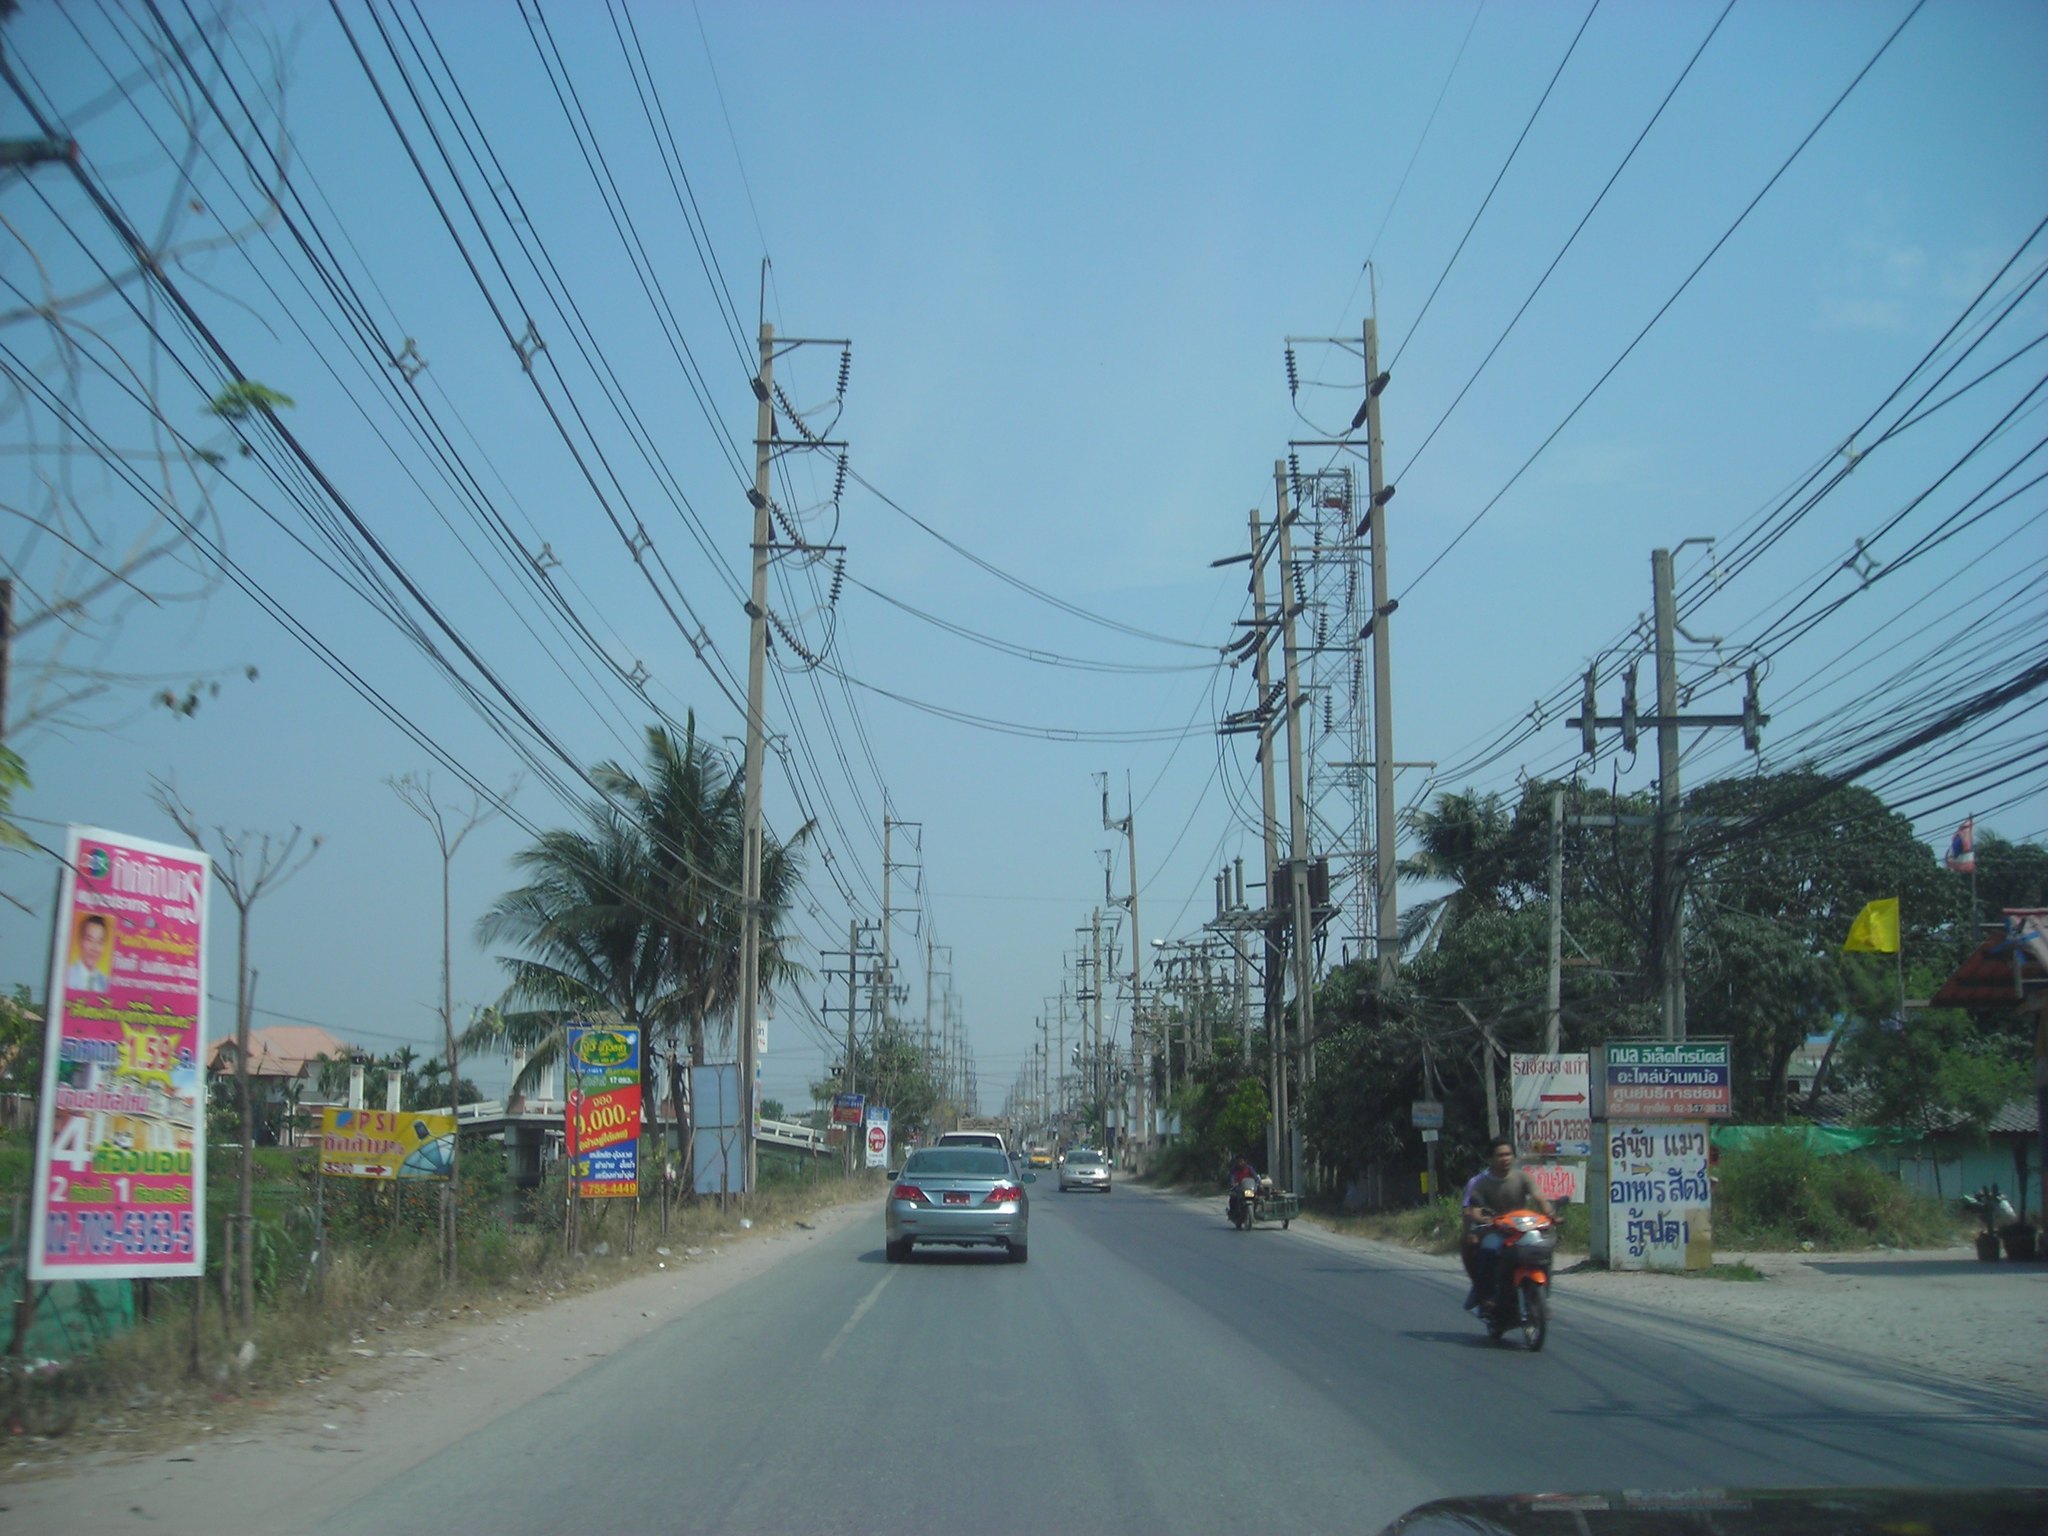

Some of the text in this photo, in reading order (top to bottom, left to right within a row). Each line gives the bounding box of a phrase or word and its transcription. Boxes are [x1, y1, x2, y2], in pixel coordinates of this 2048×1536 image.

[128, 1034, 172, 1071] 1.59
[1610, 1048, 1639, 1064] กมล
[1617, 1067, 1719, 1084] อะไหล่บ้านหม้อ
[1613, 1086, 1723, 1103] ศูนย์บริการซ่อม
[52, 1113, 193, 1175] 4 ห้องนอน
[1611, 1127, 1705, 1172] สุนัข แมว
[50, 1176, 69, 1202] 2
[114, 1177, 130, 1203] 1
[1626, 1207, 1691, 1257] ตู้ปลา
